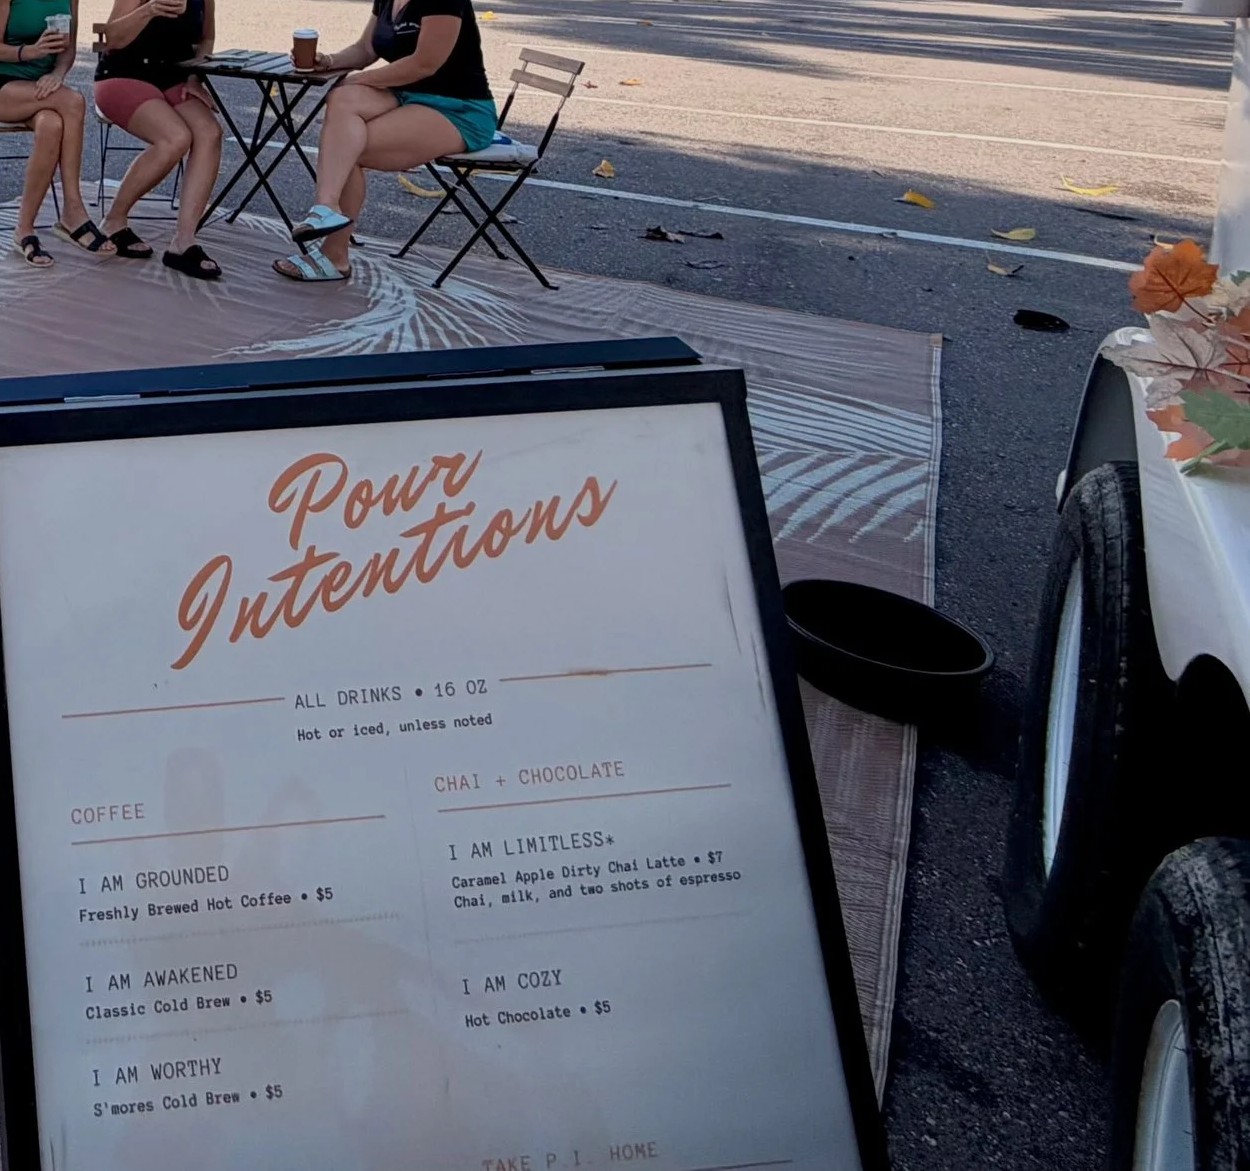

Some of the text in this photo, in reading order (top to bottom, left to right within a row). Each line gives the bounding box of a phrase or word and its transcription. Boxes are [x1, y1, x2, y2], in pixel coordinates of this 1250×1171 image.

[267, 448, 484, 551] Pour
[170, 475, 618, 670] Intentions
[294, 678, 488, 710] ALL DRINKS 16 OZ
[297, 712, 493, 742] Hot or iced, unless noted
[434, 760, 625, 793] CHAI + CHOCOLATE
[70, 802, 146, 825] COFFEE
[448, 844, 458, 861] I
[470, 841, 493, 859] AM
[78, 865, 230, 895] I AM GROUNDED
[451, 850, 723, 889] Caramel Apple Dirty Chai Latte $7
[79, 886, 334, 923] Freshly Brewed Hot Coffee $5
[453, 870, 742, 909] Chai, milk, and two shots of espresso
[85, 963, 238, 993] I AM AWAKENED
[462, 968, 562, 996] I AM COZY
[85, 989, 273, 1020] Classic Cold Brew $5
[464, 999, 611, 1028] Hot Chocolate $5
[92, 1057, 221, 1087] I AM WORTHY
[93, 1083, 283, 1118] S'mores Cold Brew $5
[482, 1156, 531, 1171] TAKE
[609, 1140, 659, 1161] HOME
